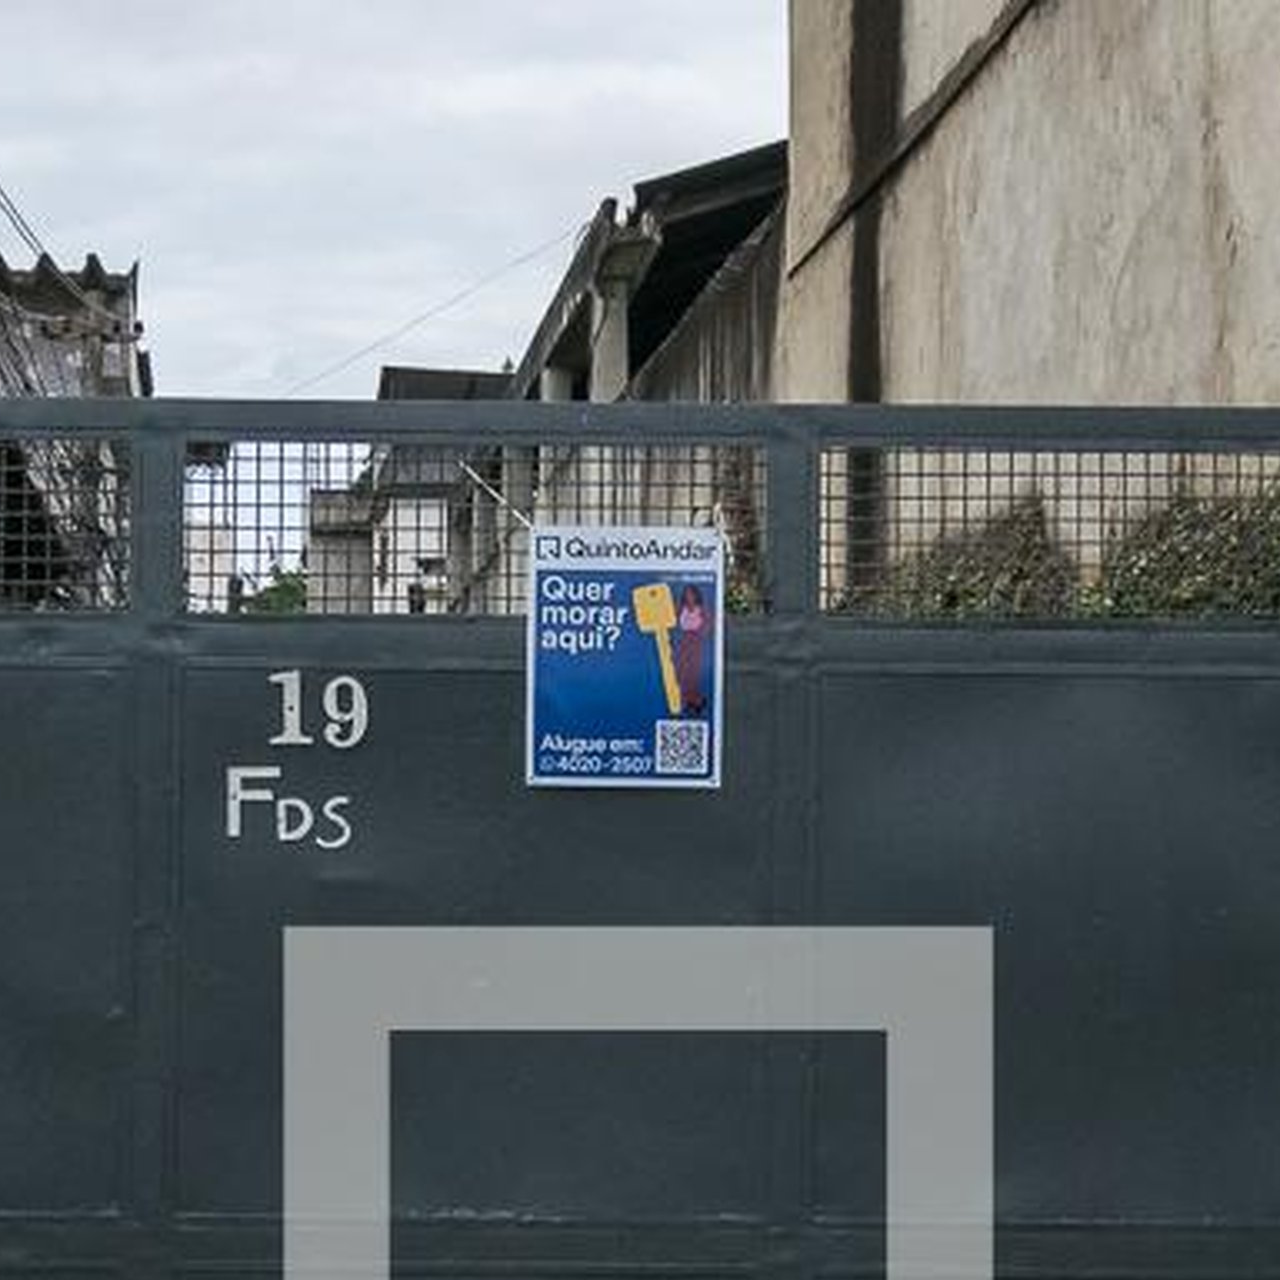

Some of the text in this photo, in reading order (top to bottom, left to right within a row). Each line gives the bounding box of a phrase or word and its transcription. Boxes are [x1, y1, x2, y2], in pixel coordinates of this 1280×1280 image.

[566, 537, 716, 560] QuintoAndar
[541, 575, 615, 600] Quer
[541, 604, 628, 625] morar
[541, 626, 621, 654] aqui?
[268, 669, 369, 748] 19
[539, 733, 607, 755] Alugue
